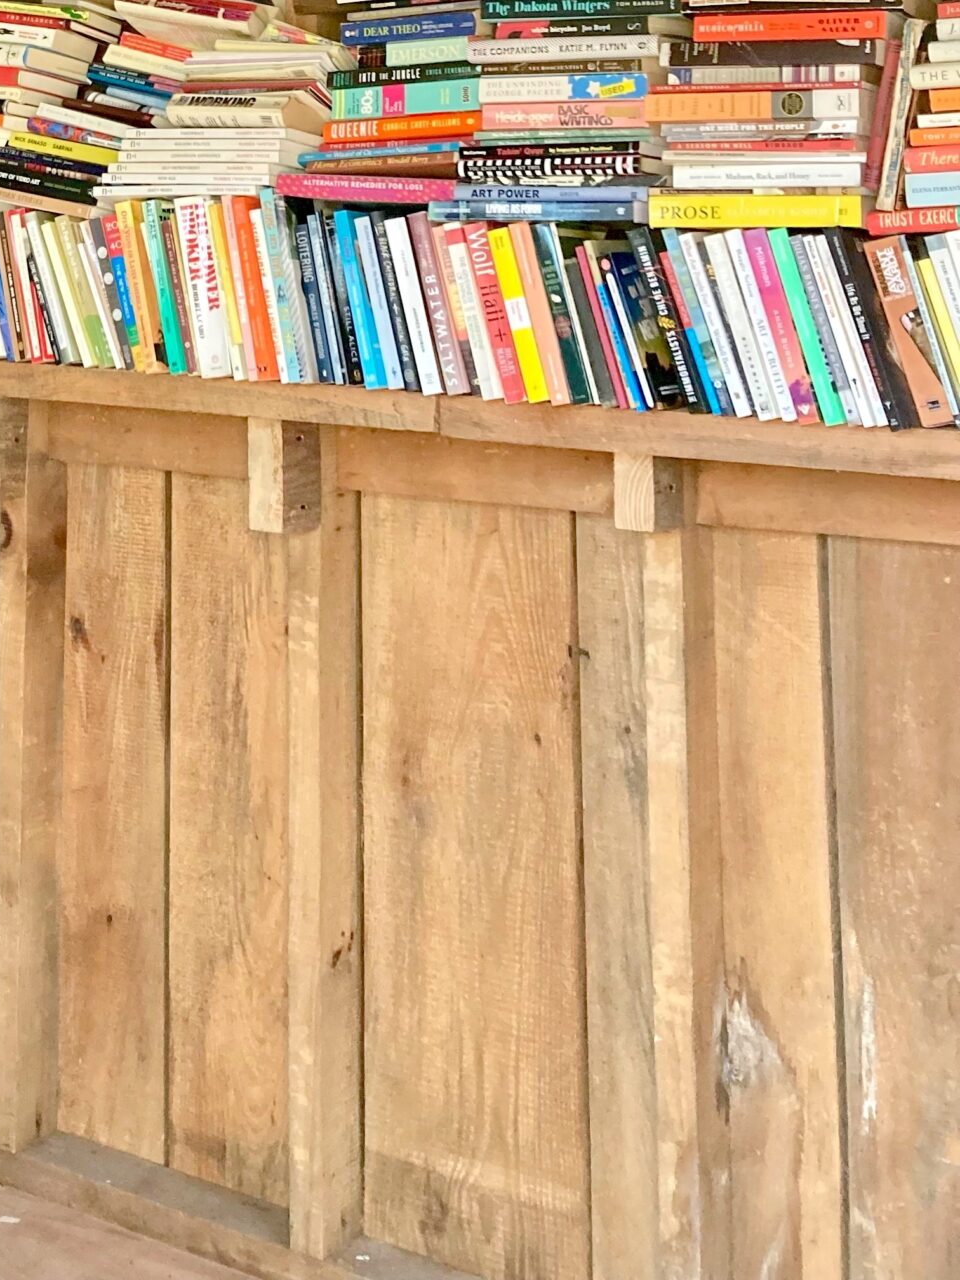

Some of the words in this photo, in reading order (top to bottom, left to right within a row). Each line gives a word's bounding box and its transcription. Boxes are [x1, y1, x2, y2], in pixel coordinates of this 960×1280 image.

[486, 2, 510, 16] The
[514, 0, 558, 12] Dakota
[561, 0, 611, 13] Winters
[363, 25, 390, 37] DEAR
[392, 23, 421, 35] THEO
[822, 25, 856, 33] SACKS
[391, 43, 461, 63] EMERSON
[472, 48, 488, 57] THE
[490, 46, 549, 56] COMPANIONS
[585, 44, 595, 52] M.
[600, 43, 627, 51] FLYNN
[358, 70, 376, 83] INTO
[379, 71, 388, 80] THE
[391, 69, 421, 81] JUNGLE
[920, 72, 949, 82] THE
[601, 84, 626, 97] USED
[189, 96, 257, 107] WORKING
[558, 105, 589, 115] BASIC
[558, 114, 613, 126] WRITINGS
[775, 123, 806, 131] PEOPLE
[331, 122, 378, 139] QUEENIE
[30, 177, 41, 185] ART
[303, 179, 349, 188] ALTERNATIVE
[351, 181, 386, 190] REMEDIES
[405, 182, 423, 191] LOSS
[471, 189, 492, 198] ART
[497, 189, 540, 198] POWER
[660, 205, 721, 219] PROSE
[878, 212, 915, 228] TRUST
[296, 231, 309, 283] LOITERING
[468, 229, 496, 275] Wolf
[638, 246, 659, 289] BENJAMIN
[754, 246, 771, 288] Milkman
[479, 283, 505, 322] Hall
[651, 289, 668, 316] CHLOE
[425, 274, 458, 387] SALTWATER
[348, 335, 358, 363] ALICE
[666, 331, 696, 395] IMMORTALISTS
